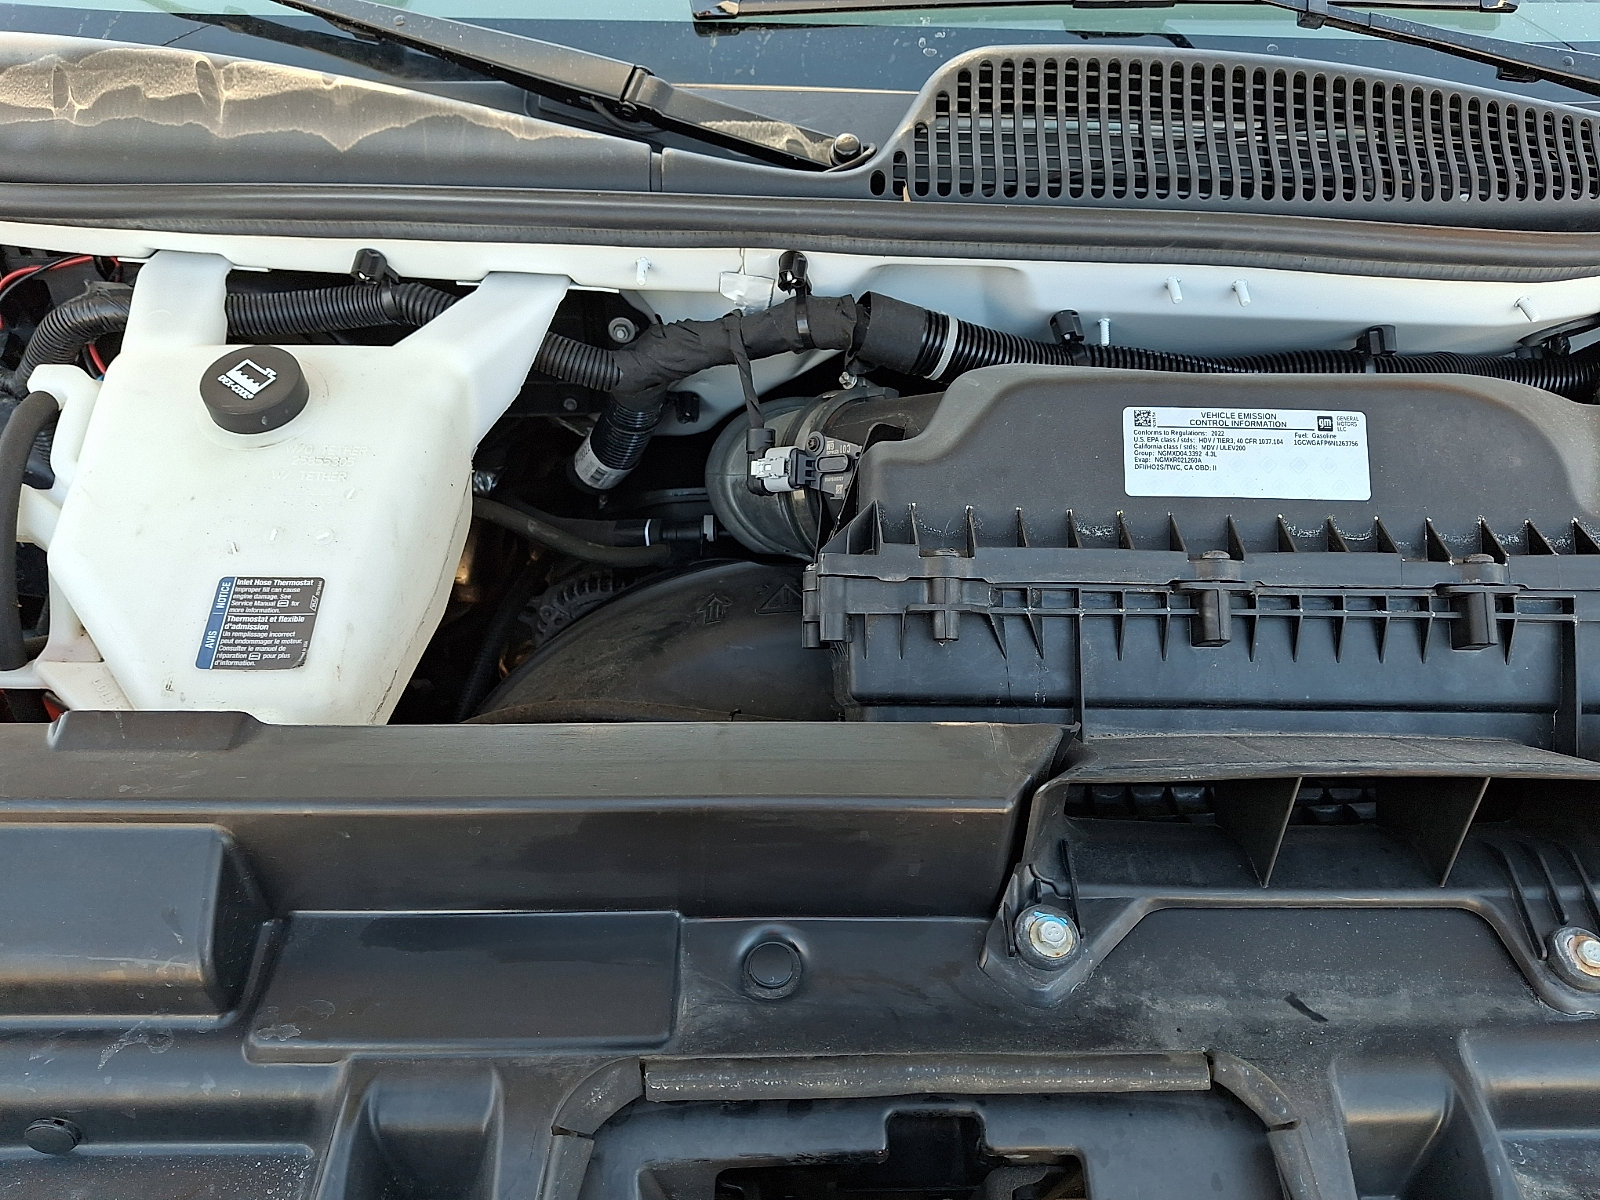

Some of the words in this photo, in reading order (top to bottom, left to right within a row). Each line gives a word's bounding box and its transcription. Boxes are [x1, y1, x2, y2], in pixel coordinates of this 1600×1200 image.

[1201, 411, 1236, 420] VEHICLE
[1237, 412, 1277, 421] EMISSION
[1189, 419, 1230, 427] CONTROL
[1231, 420, 1287, 428] INFORMATION
[216, 581, 232, 609] NOTICE
[205, 630, 218, 649] AVIS
